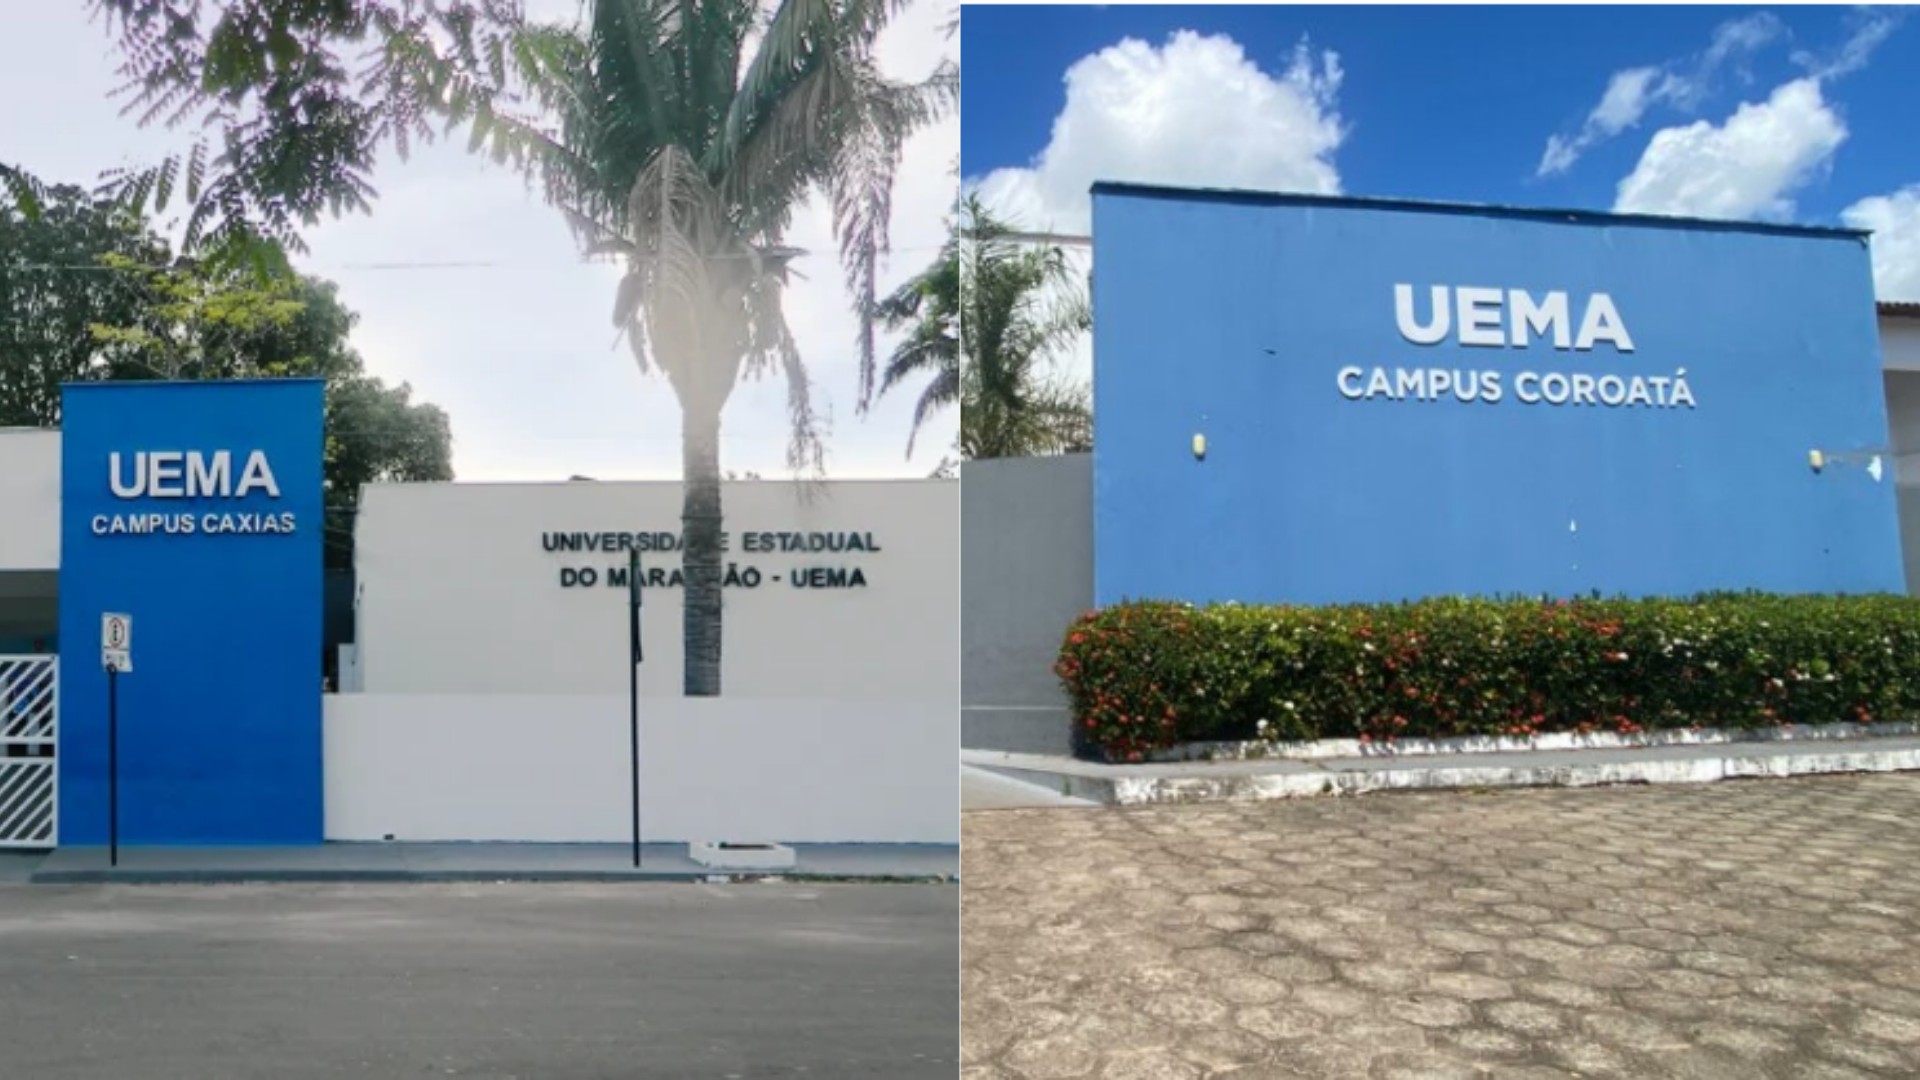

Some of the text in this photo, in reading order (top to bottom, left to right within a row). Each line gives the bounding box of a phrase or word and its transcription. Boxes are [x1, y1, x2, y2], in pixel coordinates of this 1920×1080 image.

[1393, 283, 1635, 353] UEMA
[1336, 366, 1697, 408] CAMPUS COROATÁ
[108, 449, 281, 499] UEMA
[92, 512, 296, 534] CAMPUS CAXIAS
[542, 531, 881, 552] UNIVERSIDE ESTADUAL
[559, 567, 598, 588] DO
[790, 567, 867, 589] UEMA
